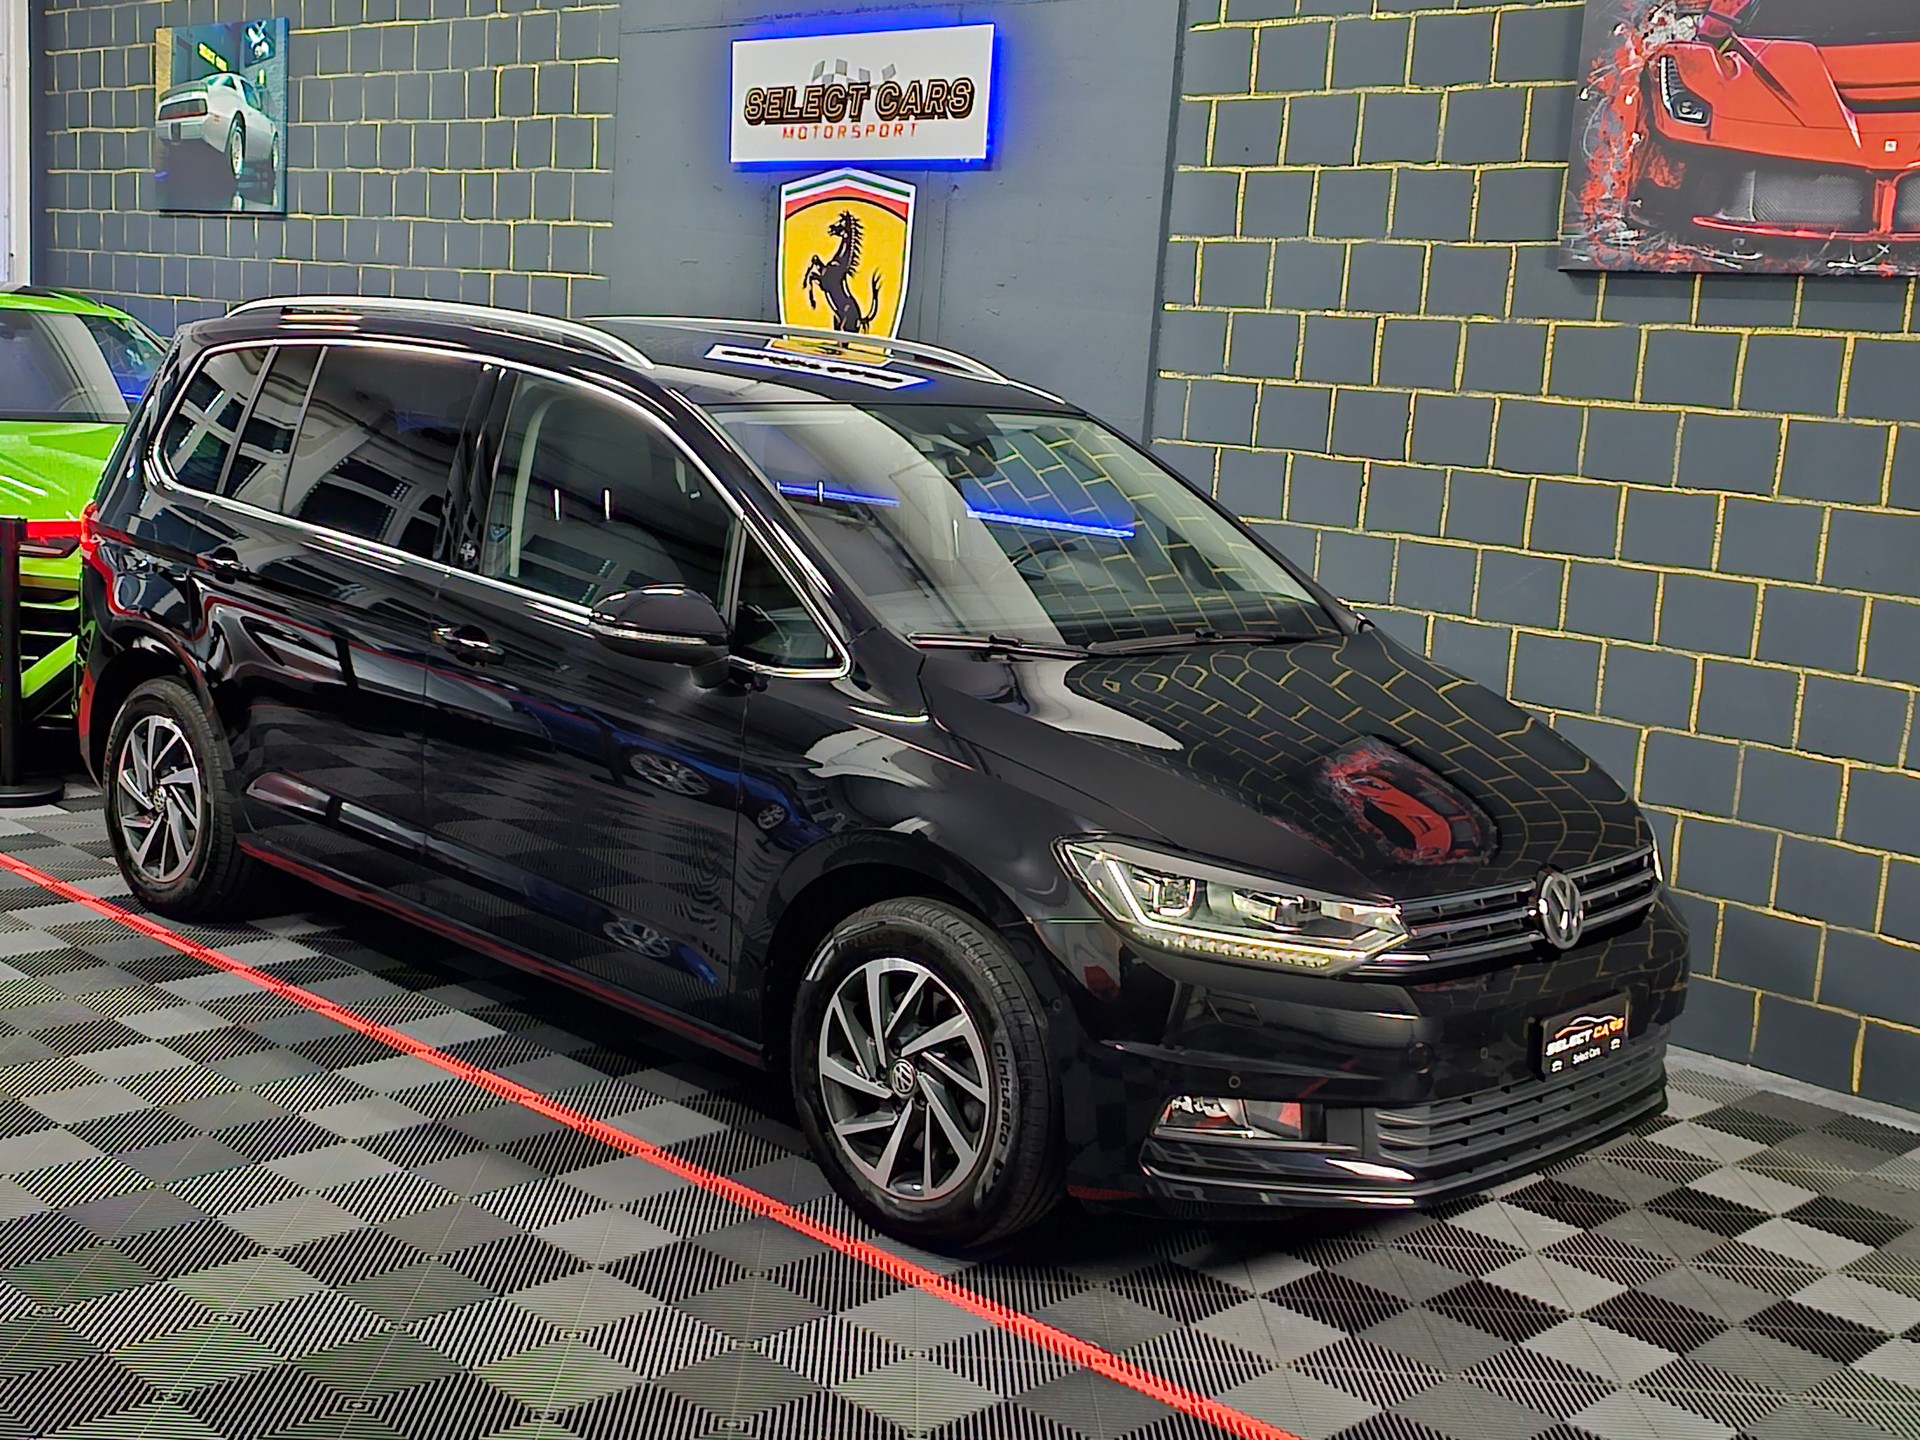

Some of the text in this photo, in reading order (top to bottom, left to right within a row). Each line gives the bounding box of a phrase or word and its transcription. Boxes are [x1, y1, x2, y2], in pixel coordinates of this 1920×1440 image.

[744, 77, 975, 125] SELECT CARS
[782, 123, 918, 140] MOTORSPORT
